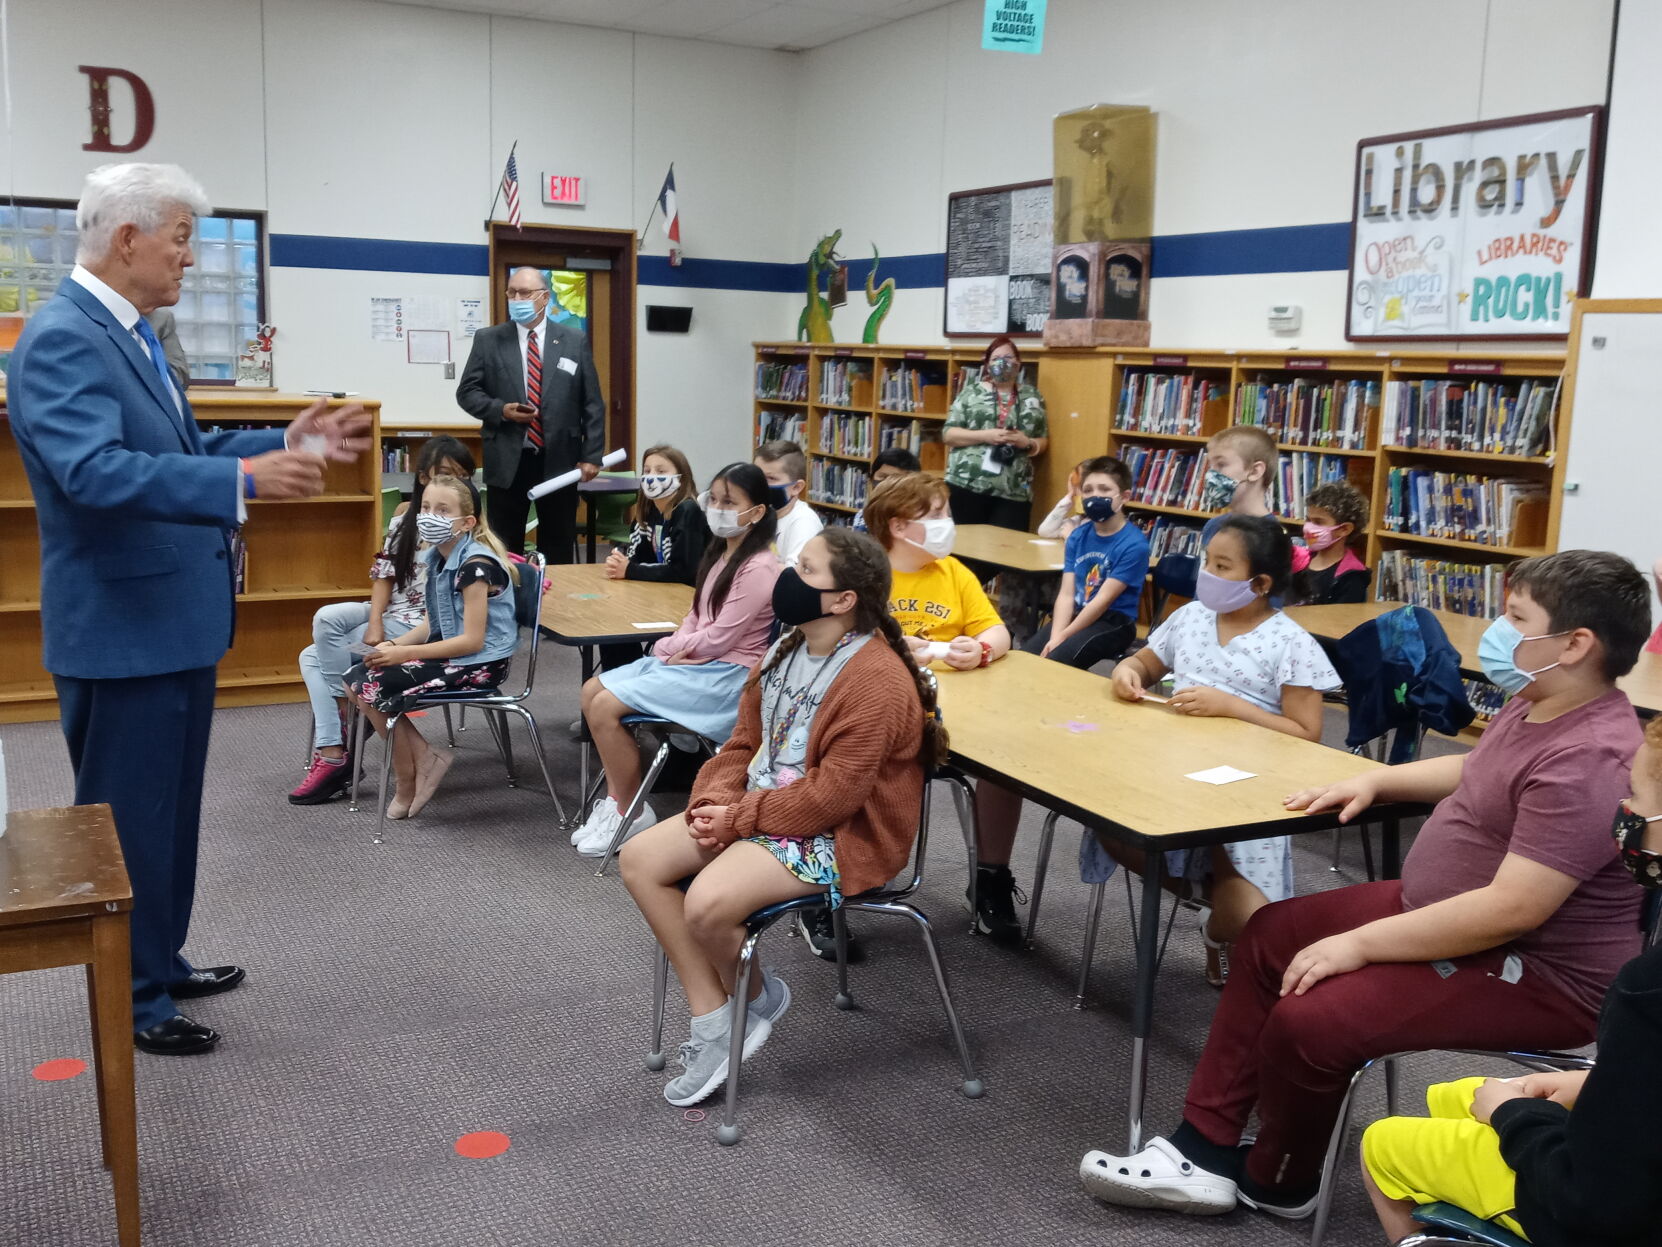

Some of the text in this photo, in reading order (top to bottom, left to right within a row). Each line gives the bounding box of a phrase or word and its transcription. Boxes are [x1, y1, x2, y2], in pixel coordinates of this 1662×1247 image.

[996, 10, 1034, 24] VOLTAGE
[1004, 0, 1027, 11] HIGH
[992, 22, 1036, 36] READERS!
[78, 65, 155, 153] D
[551, 175, 581, 202] EXIT
[1363, 142, 1586, 229] Library
[1365, 235, 1417, 275] Open
[1476, 232, 1570, 266] LIBRARIES
[1470, 271, 1563, 322] ROCK!
[889, 599, 951, 619] ACK 251
